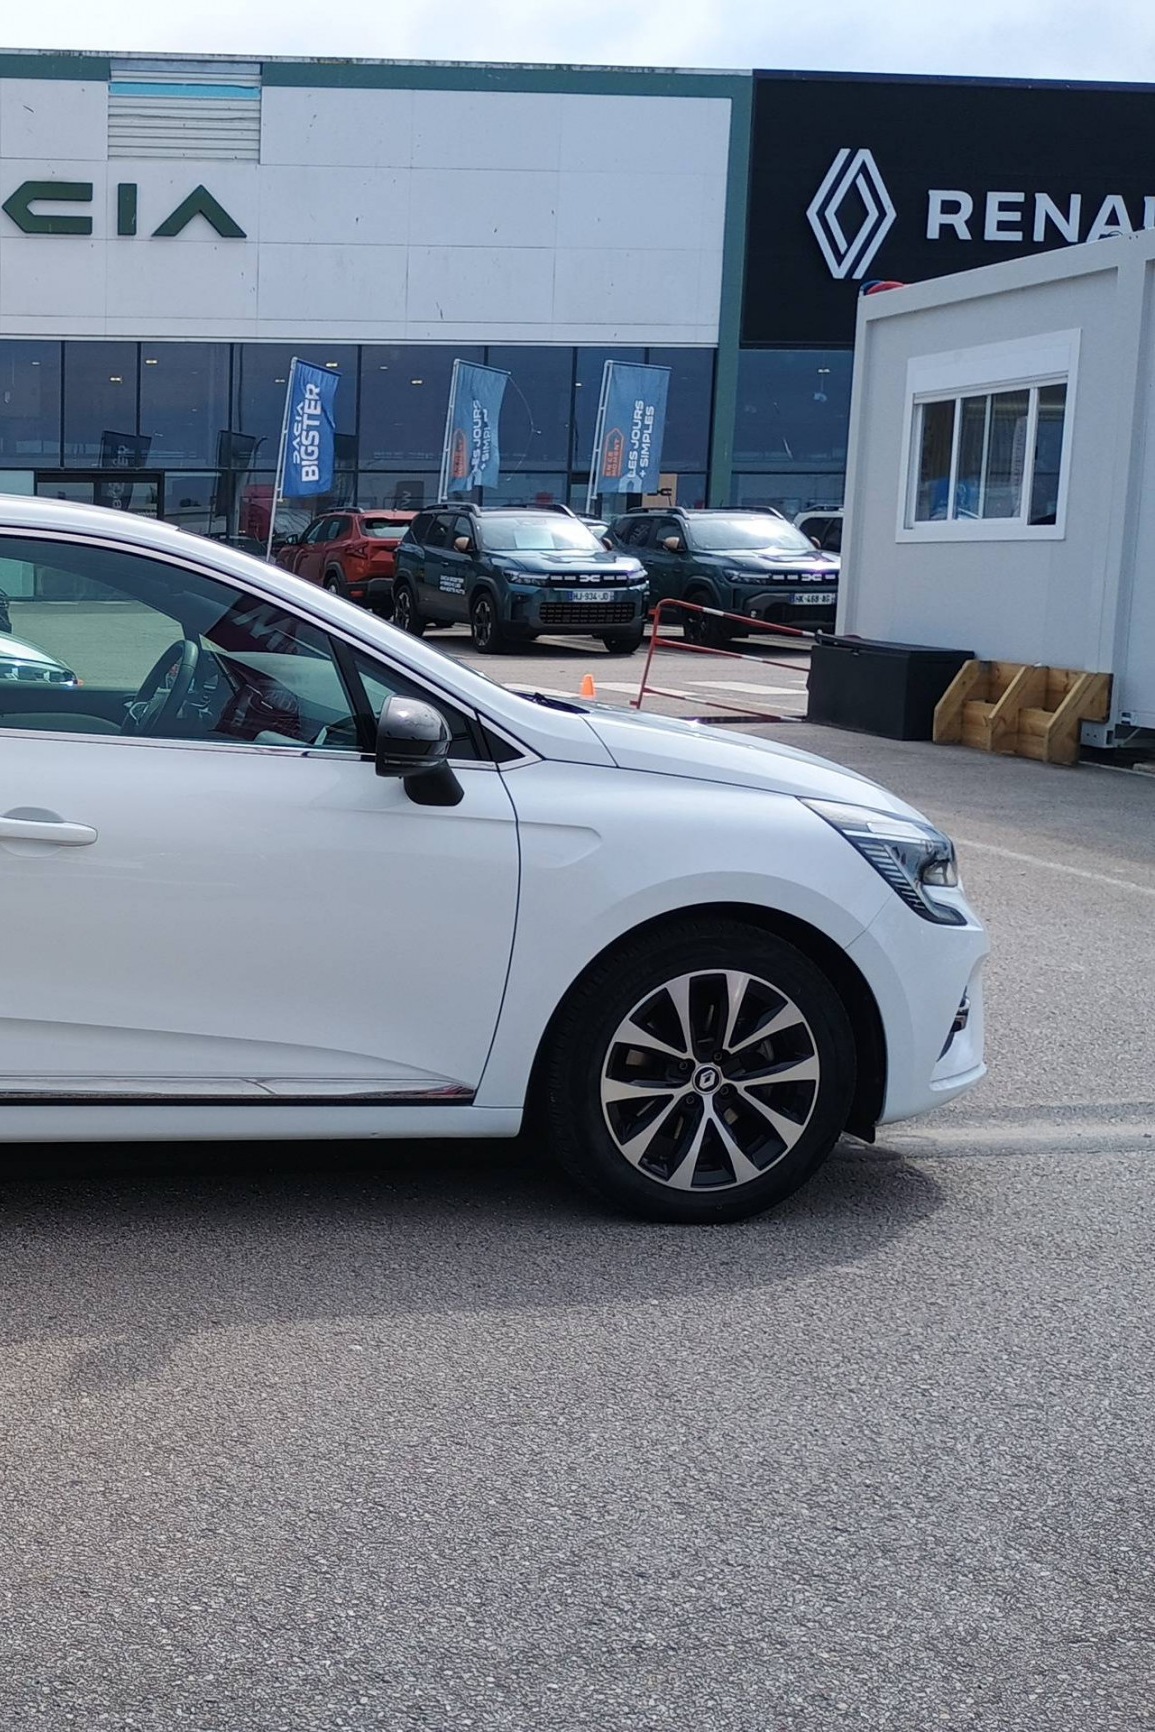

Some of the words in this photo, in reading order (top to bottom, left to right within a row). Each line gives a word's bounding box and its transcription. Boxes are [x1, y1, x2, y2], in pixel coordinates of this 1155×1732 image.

[292, 401, 304, 465] DACIA
[300, 383, 321, 481] BIGSTER
[481, 408, 492, 462] SIMP
[631, 400, 644, 449] JOURS
[640, 405, 654, 467] SIMPLES
[628, 451, 638, 478] LES
